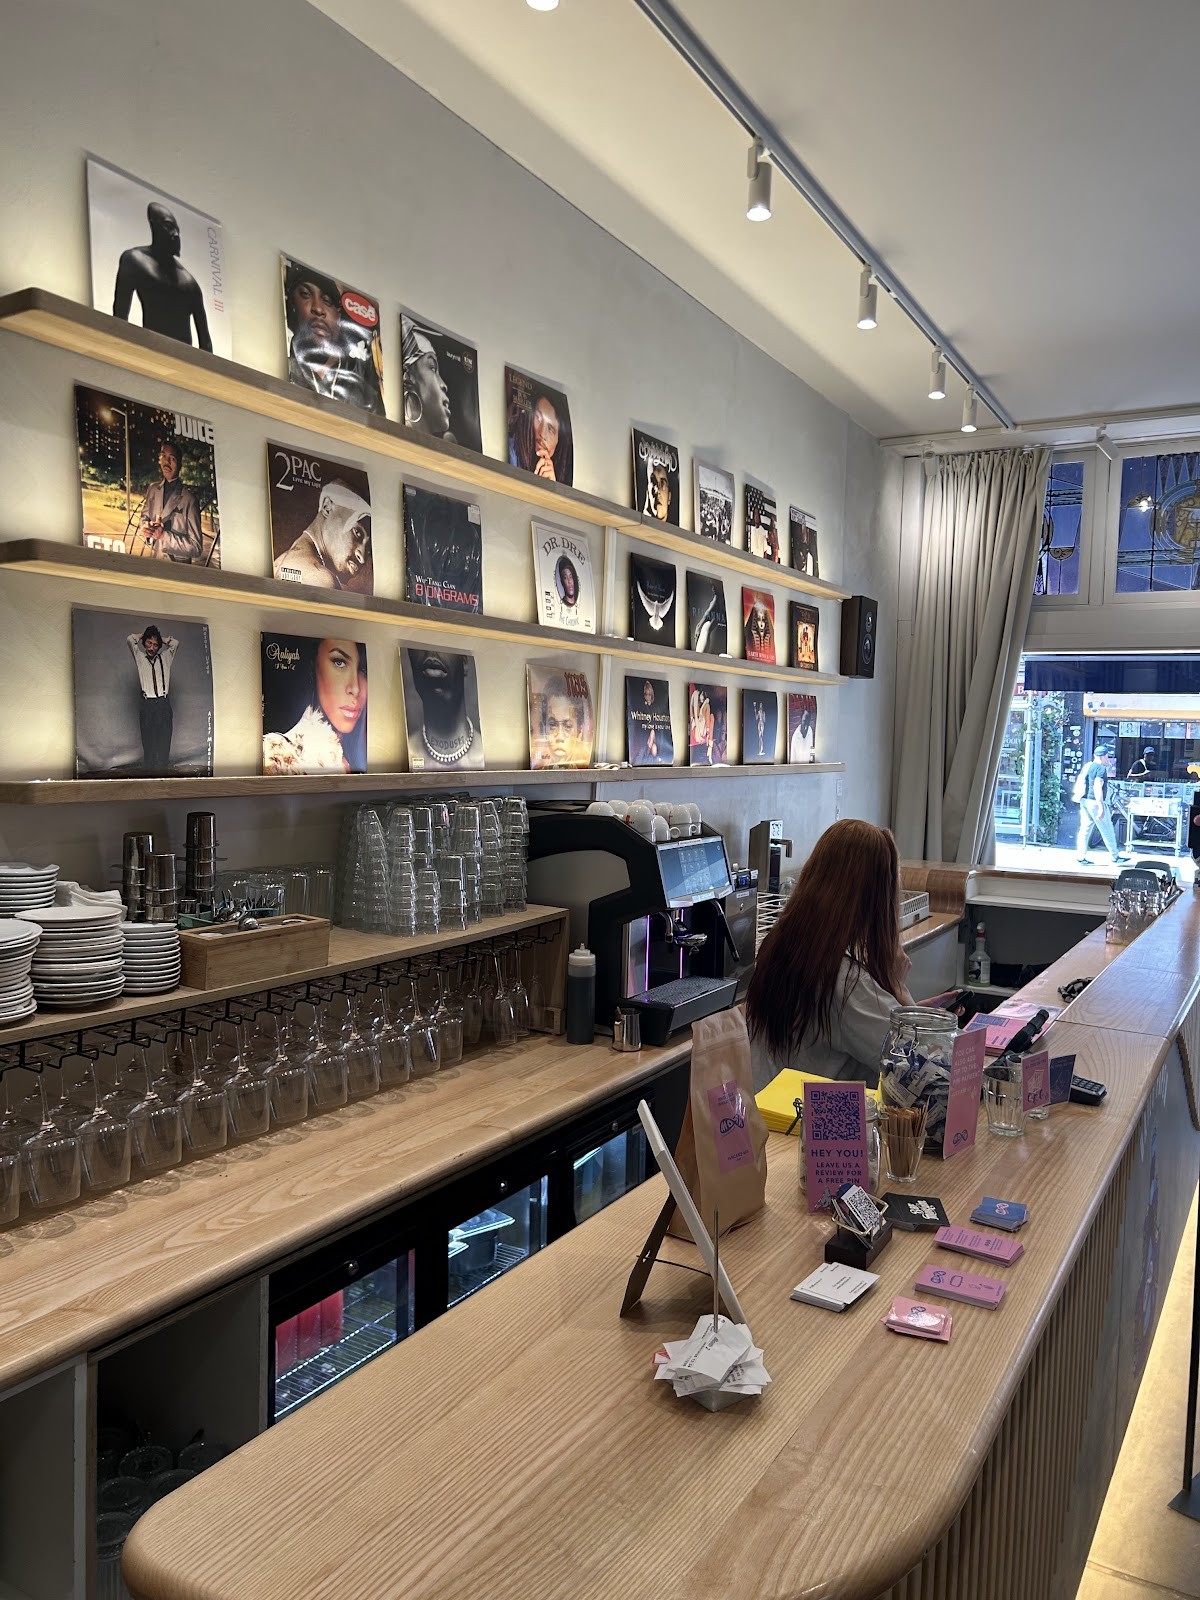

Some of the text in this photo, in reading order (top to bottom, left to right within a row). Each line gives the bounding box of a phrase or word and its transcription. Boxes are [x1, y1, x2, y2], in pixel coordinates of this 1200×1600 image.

[207, 227, 224, 313] CARNIVAL III
[344, 298, 376, 322] case
[174, 413, 215, 446] JUICE
[274, 451, 322, 491] 2PAC
[542, 536, 586, 566] DR. DRE
[415, 583, 479, 607] 8 DIAGRAMS
[691, 606, 726, 623] RIANNA
[630, 710, 652, 723] Whitney
[811, 1149, 864, 1158] HEY YOU!
